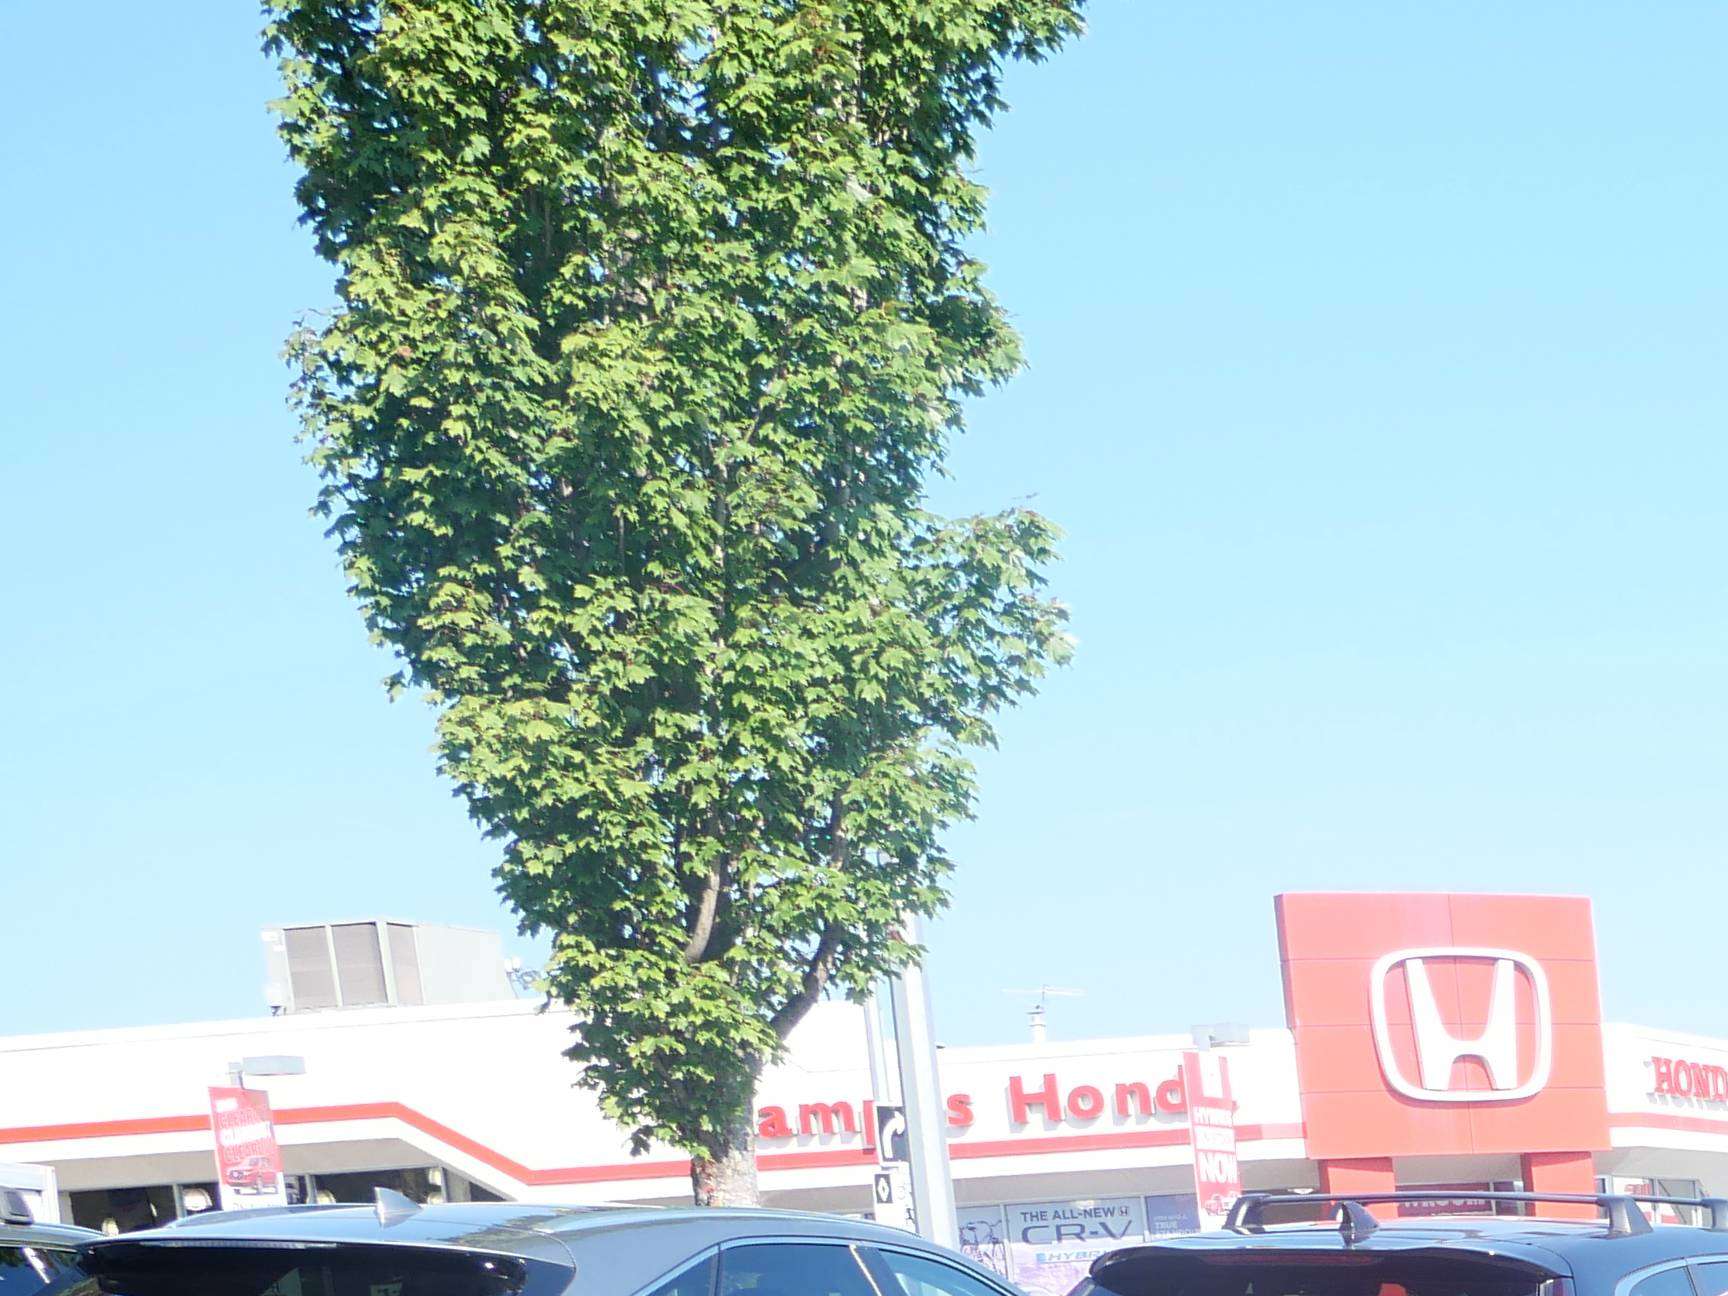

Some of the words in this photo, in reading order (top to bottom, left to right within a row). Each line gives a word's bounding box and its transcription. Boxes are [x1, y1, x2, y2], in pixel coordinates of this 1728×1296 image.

[1009, 1064, 1188, 1124] Hond
[1021, 1211, 1047, 1222] THE
[1052, 1208, 1116, 1221] ALL-NEW
[1021, 1220, 1132, 1244] CR-V
